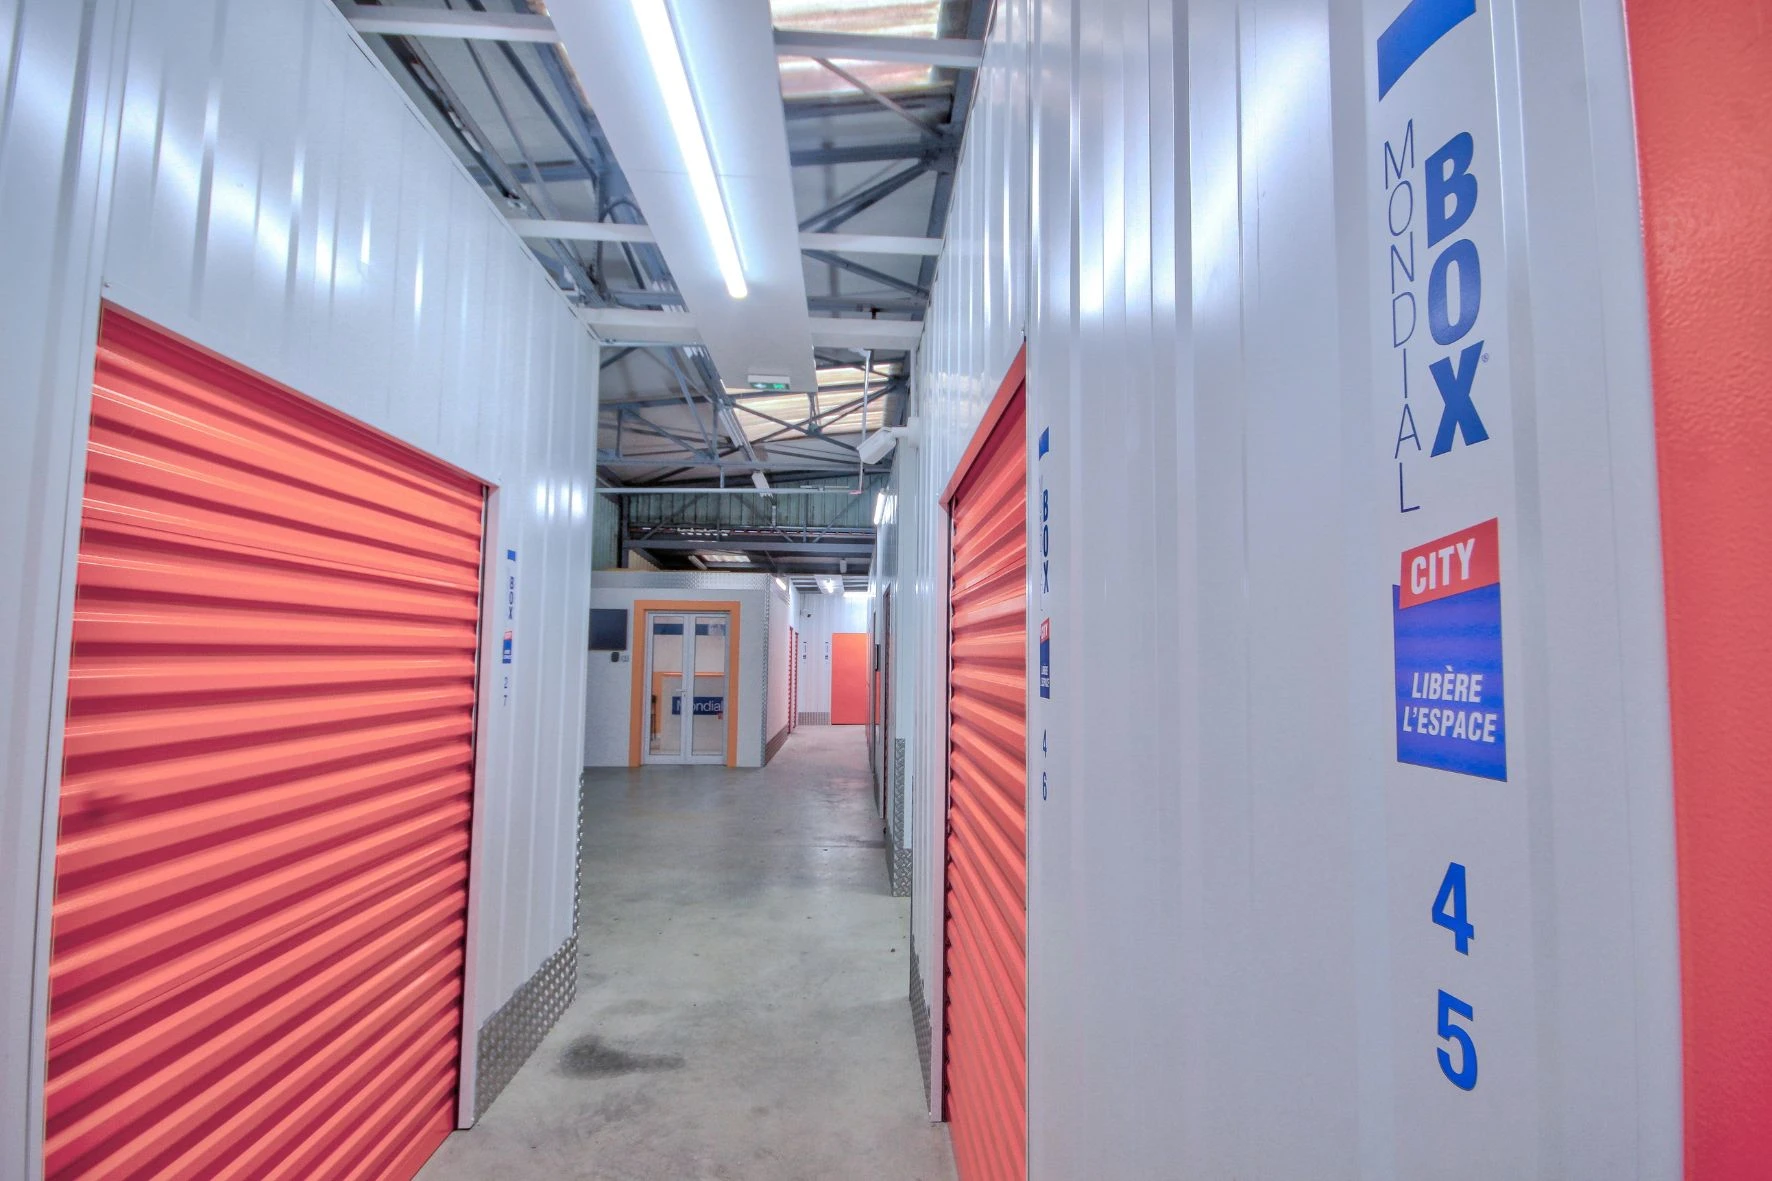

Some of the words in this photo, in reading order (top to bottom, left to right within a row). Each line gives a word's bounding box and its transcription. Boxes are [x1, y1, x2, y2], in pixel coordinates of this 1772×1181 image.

[1384, 118, 1421, 513] MONDIAL
[1410, 538, 1475, 595] CITY
[1411, 665, 1483, 703] LIBÈRE
[1402, 706, 1497, 743] L'ESPACE
[1042, 729, 1048, 801] 46
[1431, 861, 1478, 1092] 45
